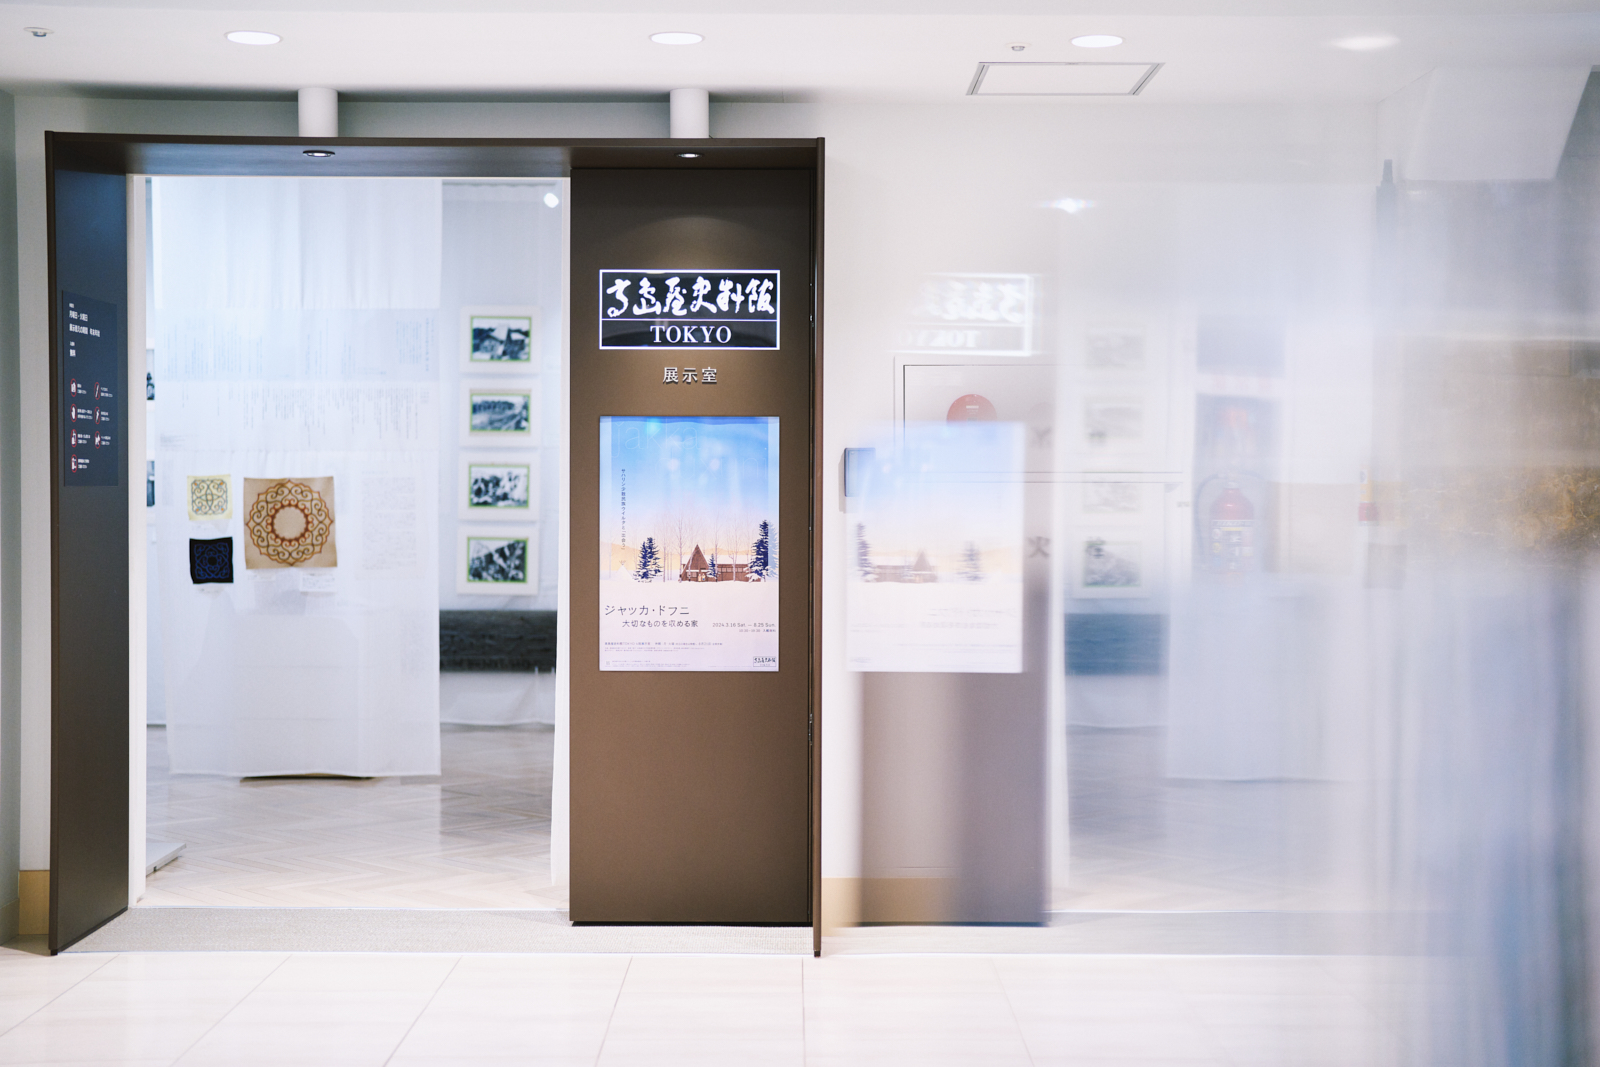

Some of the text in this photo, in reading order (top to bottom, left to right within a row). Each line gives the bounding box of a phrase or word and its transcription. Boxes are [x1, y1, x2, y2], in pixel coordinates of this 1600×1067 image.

[606, 276, 775, 317] 高島屋史料館
[650, 325, 732, 343] TOKYO
[663, 367, 717, 384] 展示室
[604, 605, 690, 616] ジャッカ・ドフニ
[622, 619, 699, 628] 大切なものを収める家
